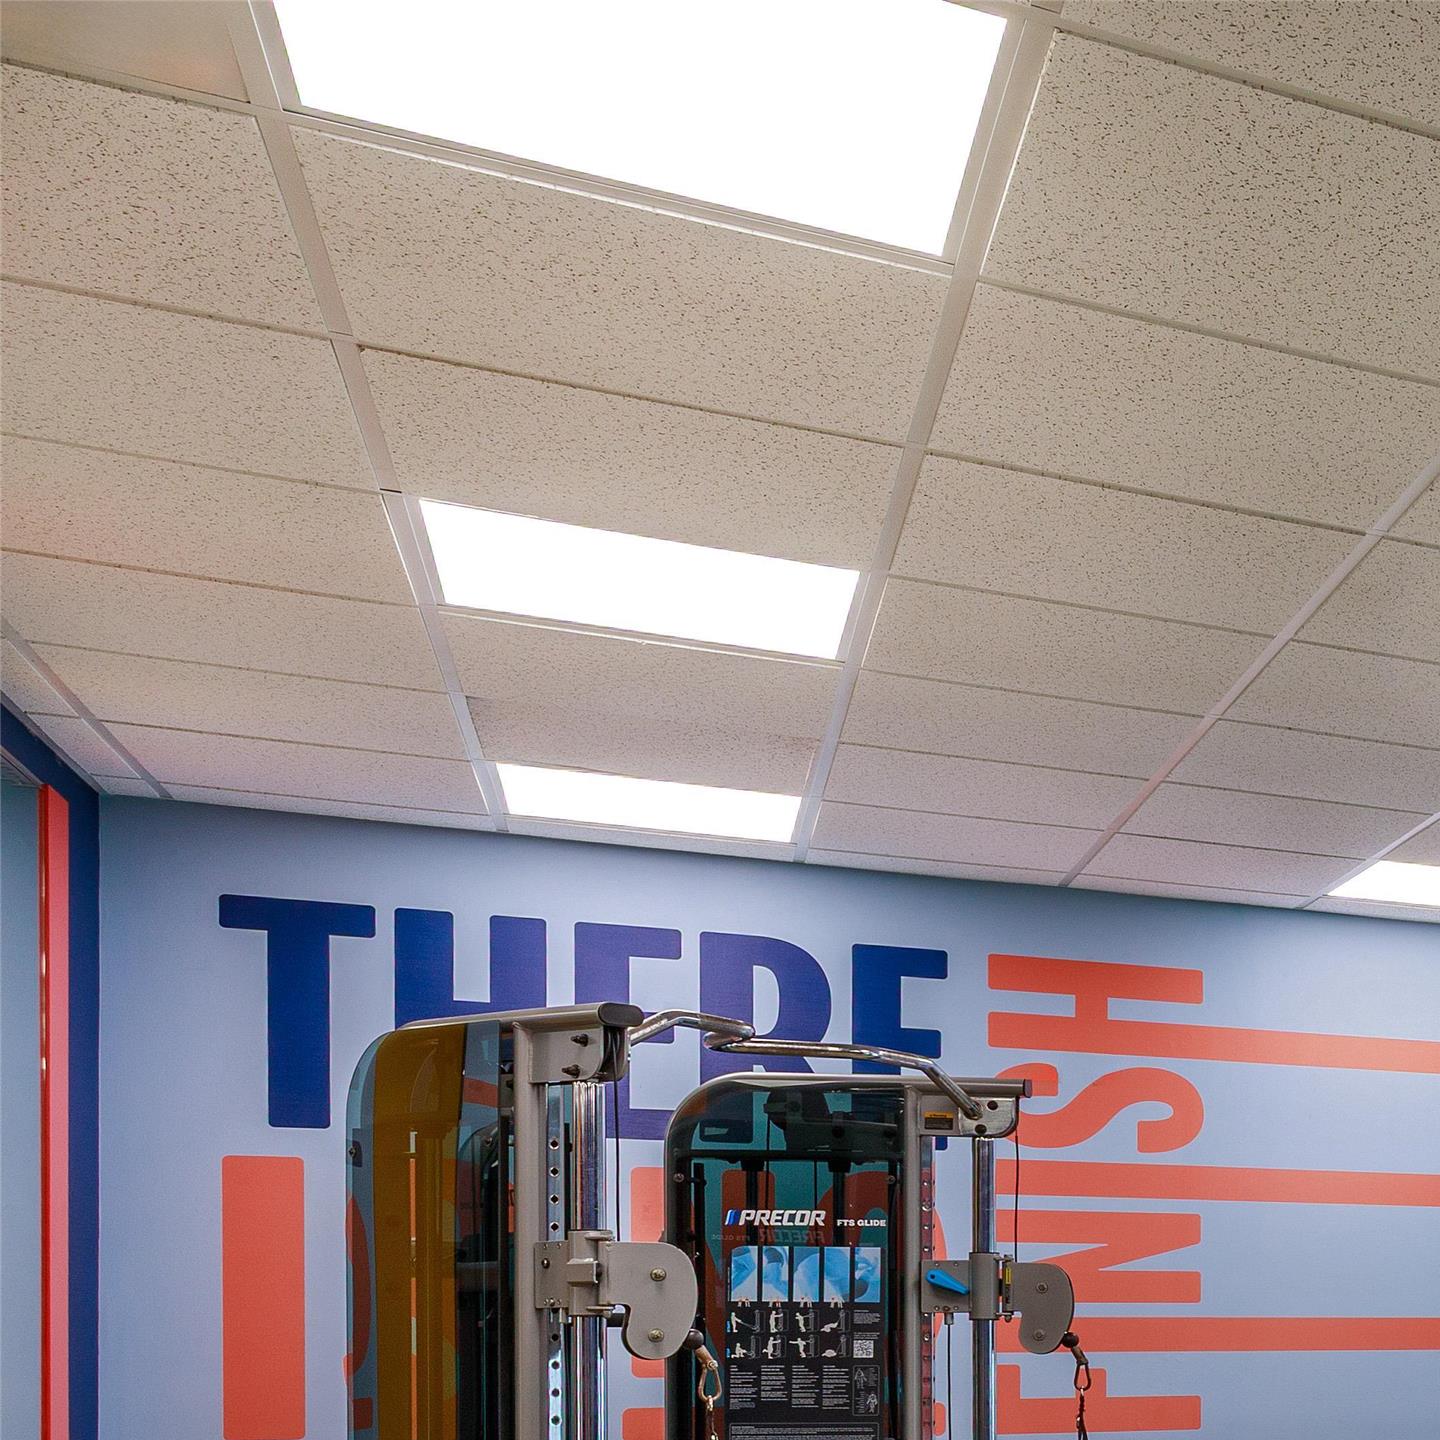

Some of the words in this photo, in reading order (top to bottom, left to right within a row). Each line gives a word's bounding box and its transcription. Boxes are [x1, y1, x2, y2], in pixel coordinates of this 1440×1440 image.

[738, 1209, 826, 1226] PRECOR
[836, 1219, 855, 1227] FTS
[857, 1219, 887, 1227] GLIDE
